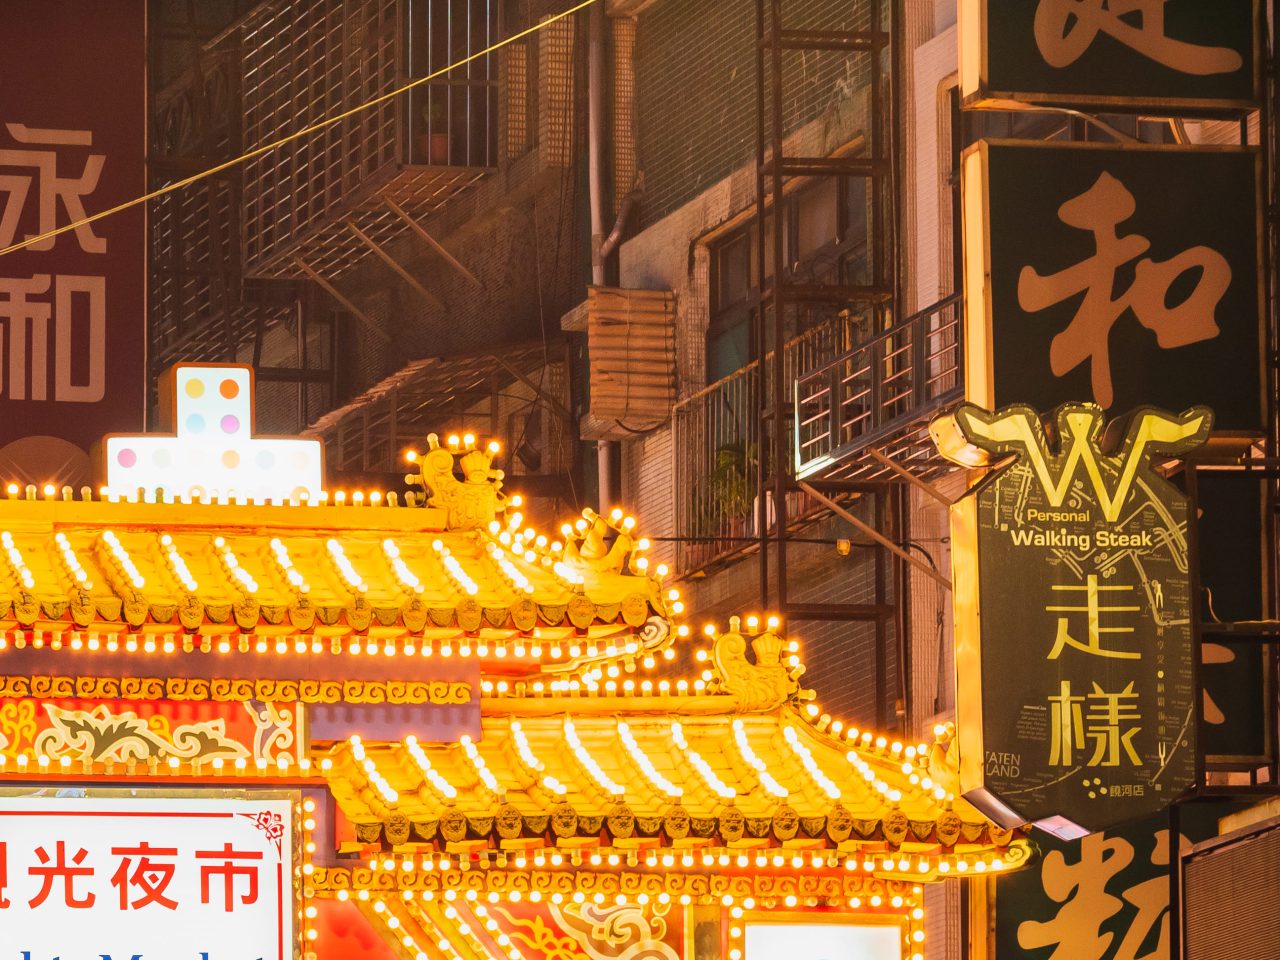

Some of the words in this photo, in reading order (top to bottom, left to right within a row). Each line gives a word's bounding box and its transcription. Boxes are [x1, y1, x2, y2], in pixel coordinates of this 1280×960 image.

[1027, 508, 1090, 522] Personal
[1011, 528, 1091, 550] Walking
[1096, 531, 1152, 547] Steak
[1046, 574, 1143, 766] 走樣
